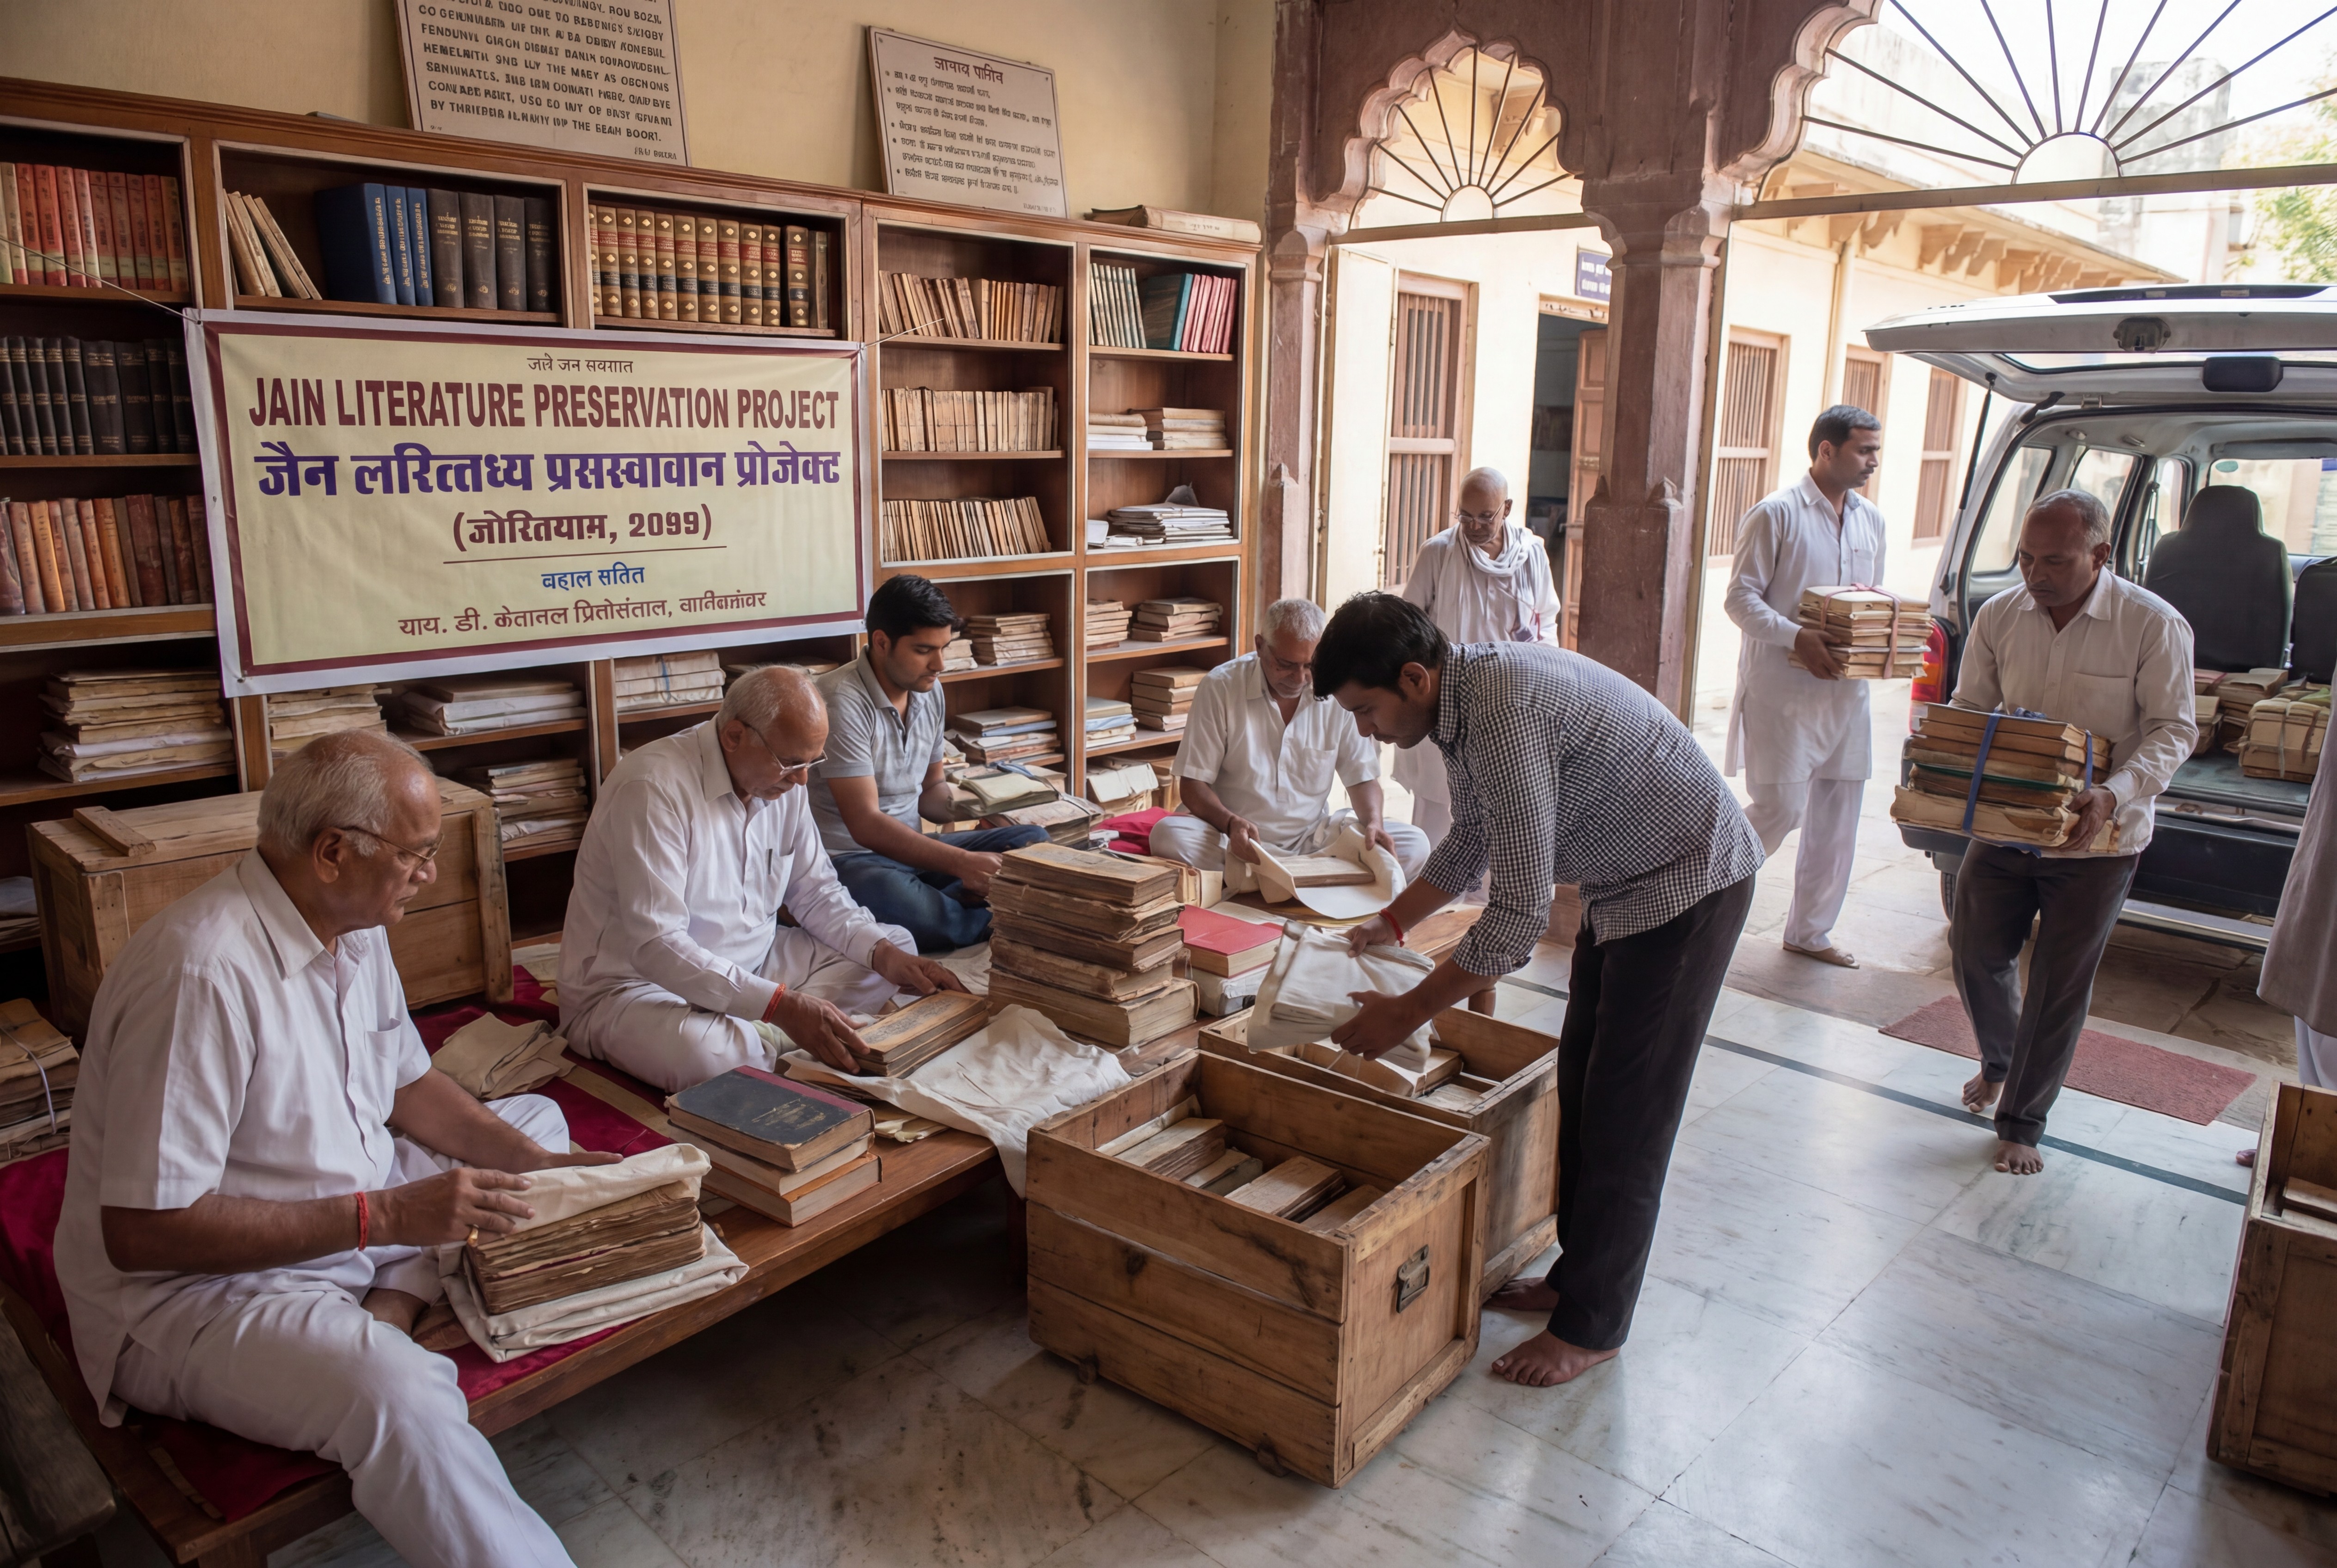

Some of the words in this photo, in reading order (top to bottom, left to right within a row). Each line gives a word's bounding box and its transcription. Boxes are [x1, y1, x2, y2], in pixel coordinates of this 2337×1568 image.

[419, 5, 435, 16] CO
[547, 63, 566, 75] THE
[605, 74, 616, 83] AS
[431, 100, 444, 110] BY
[572, 120, 590, 131] THE
[557, 359, 581, 371] जन
[249, 378, 326, 426] JAIN
[336, 380, 525, 427] LITERATURE
[534, 384, 728, 428] PRESERVATION
[738, 389, 838, 429] PROJECT
[254, 441, 339, 496] जैन
[734, 441, 840, 487] प्रोजेक्ट
[598, 562, 644, 585] सतित
[454, 607, 487, 631] डी.
